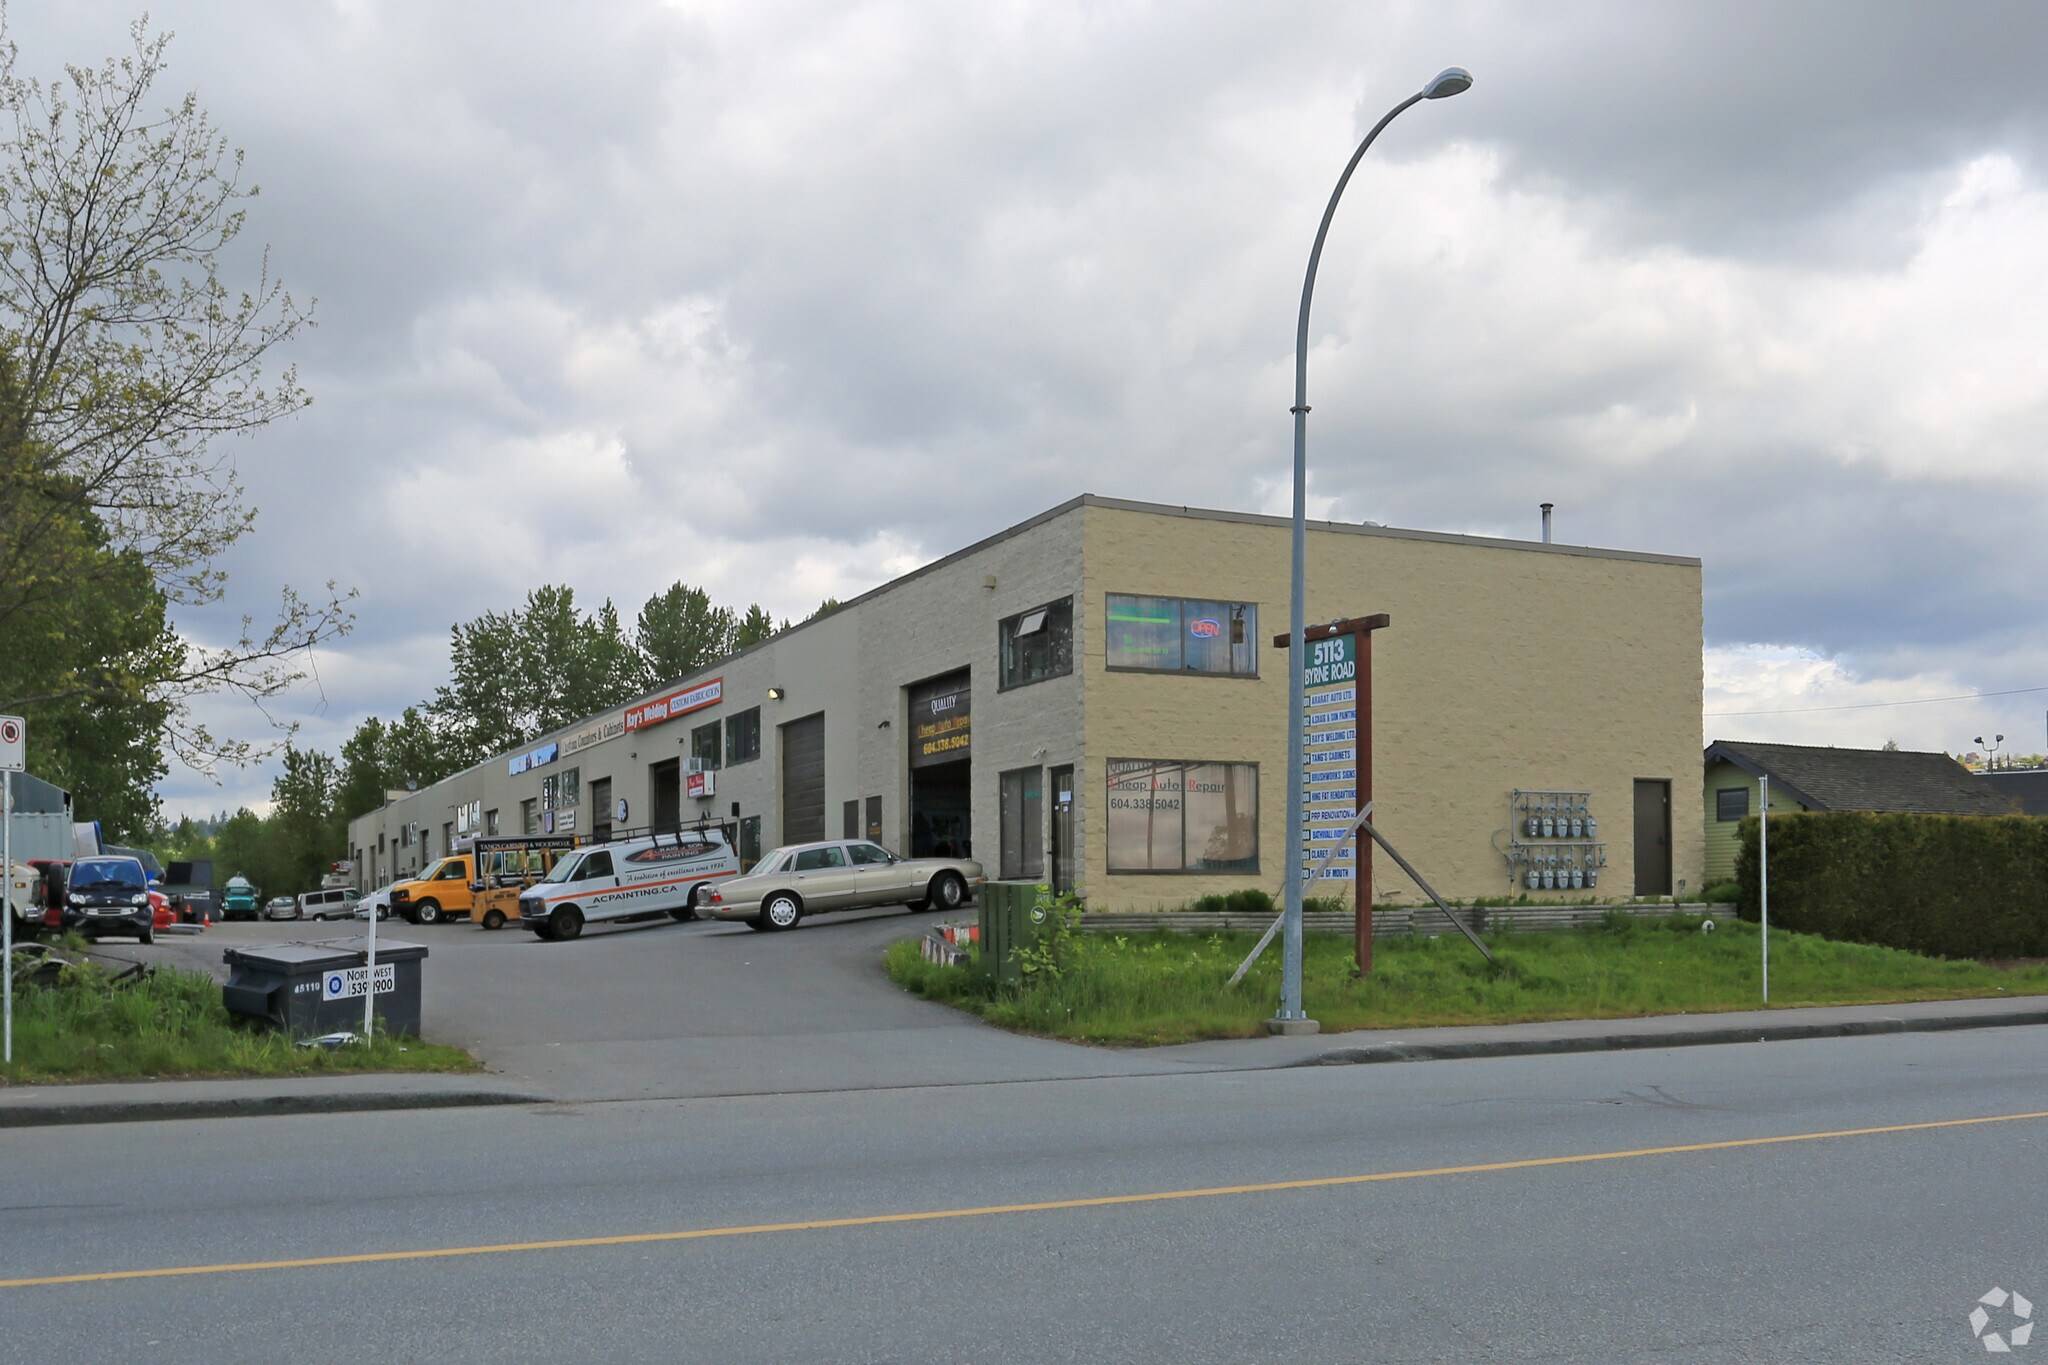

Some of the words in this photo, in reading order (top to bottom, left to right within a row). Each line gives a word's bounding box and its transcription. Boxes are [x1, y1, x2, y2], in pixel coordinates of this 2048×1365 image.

[1191, 620, 1219, 637] OPEN
[1314, 639, 1344, 665] 5113
[1304, 665, 1329, 685] BYRNE
[1331, 661, 1355, 680] ROAD
[671, 698, 689, 711] CUSTOM
[689, 684, 720, 705] FABRICATION
[1311, 694, 1329, 705] ARARAT
[1330, 692, 1342, 702] AUTO
[931, 694, 957, 715] QUALITY
[626, 709, 643, 728] Ray's
[643, 703, 668, 721] Welding
[1330, 711, 1339, 721] SON
[603, 721, 624, 738] Cabinets
[1311, 733, 1324, 743] RAY'S
[1325, 731, 1346, 741] WELDING
[1311, 753, 1328, 763] TANG'S
[1328, 750, 1351, 761] CABINETS
[1311, 771, 1341, 782] BRUSHWORKS
[1342, 769, 1356, 779] SIGNS
[1151, 777, 1180, 790] Auto
[1188, 778, 1225, 793] Repair
[1321, 791, 1330, 800] FAT
[1311, 812, 1320, 821] PRP
[1321, 810, 1350, 819] RENOVATION
[1312, 830, 1333, 839] BATHWALL
[661, 850, 699, 860] PAINTING
[659, 871, 667, 880] of
[1325, 869, 1331, 877] OF
[1332, 868, 1349, 877] MOUTH
[592, 885, 678, 904] ACPAINTING.CA
[347, 967, 392, 982] NORTWEST
